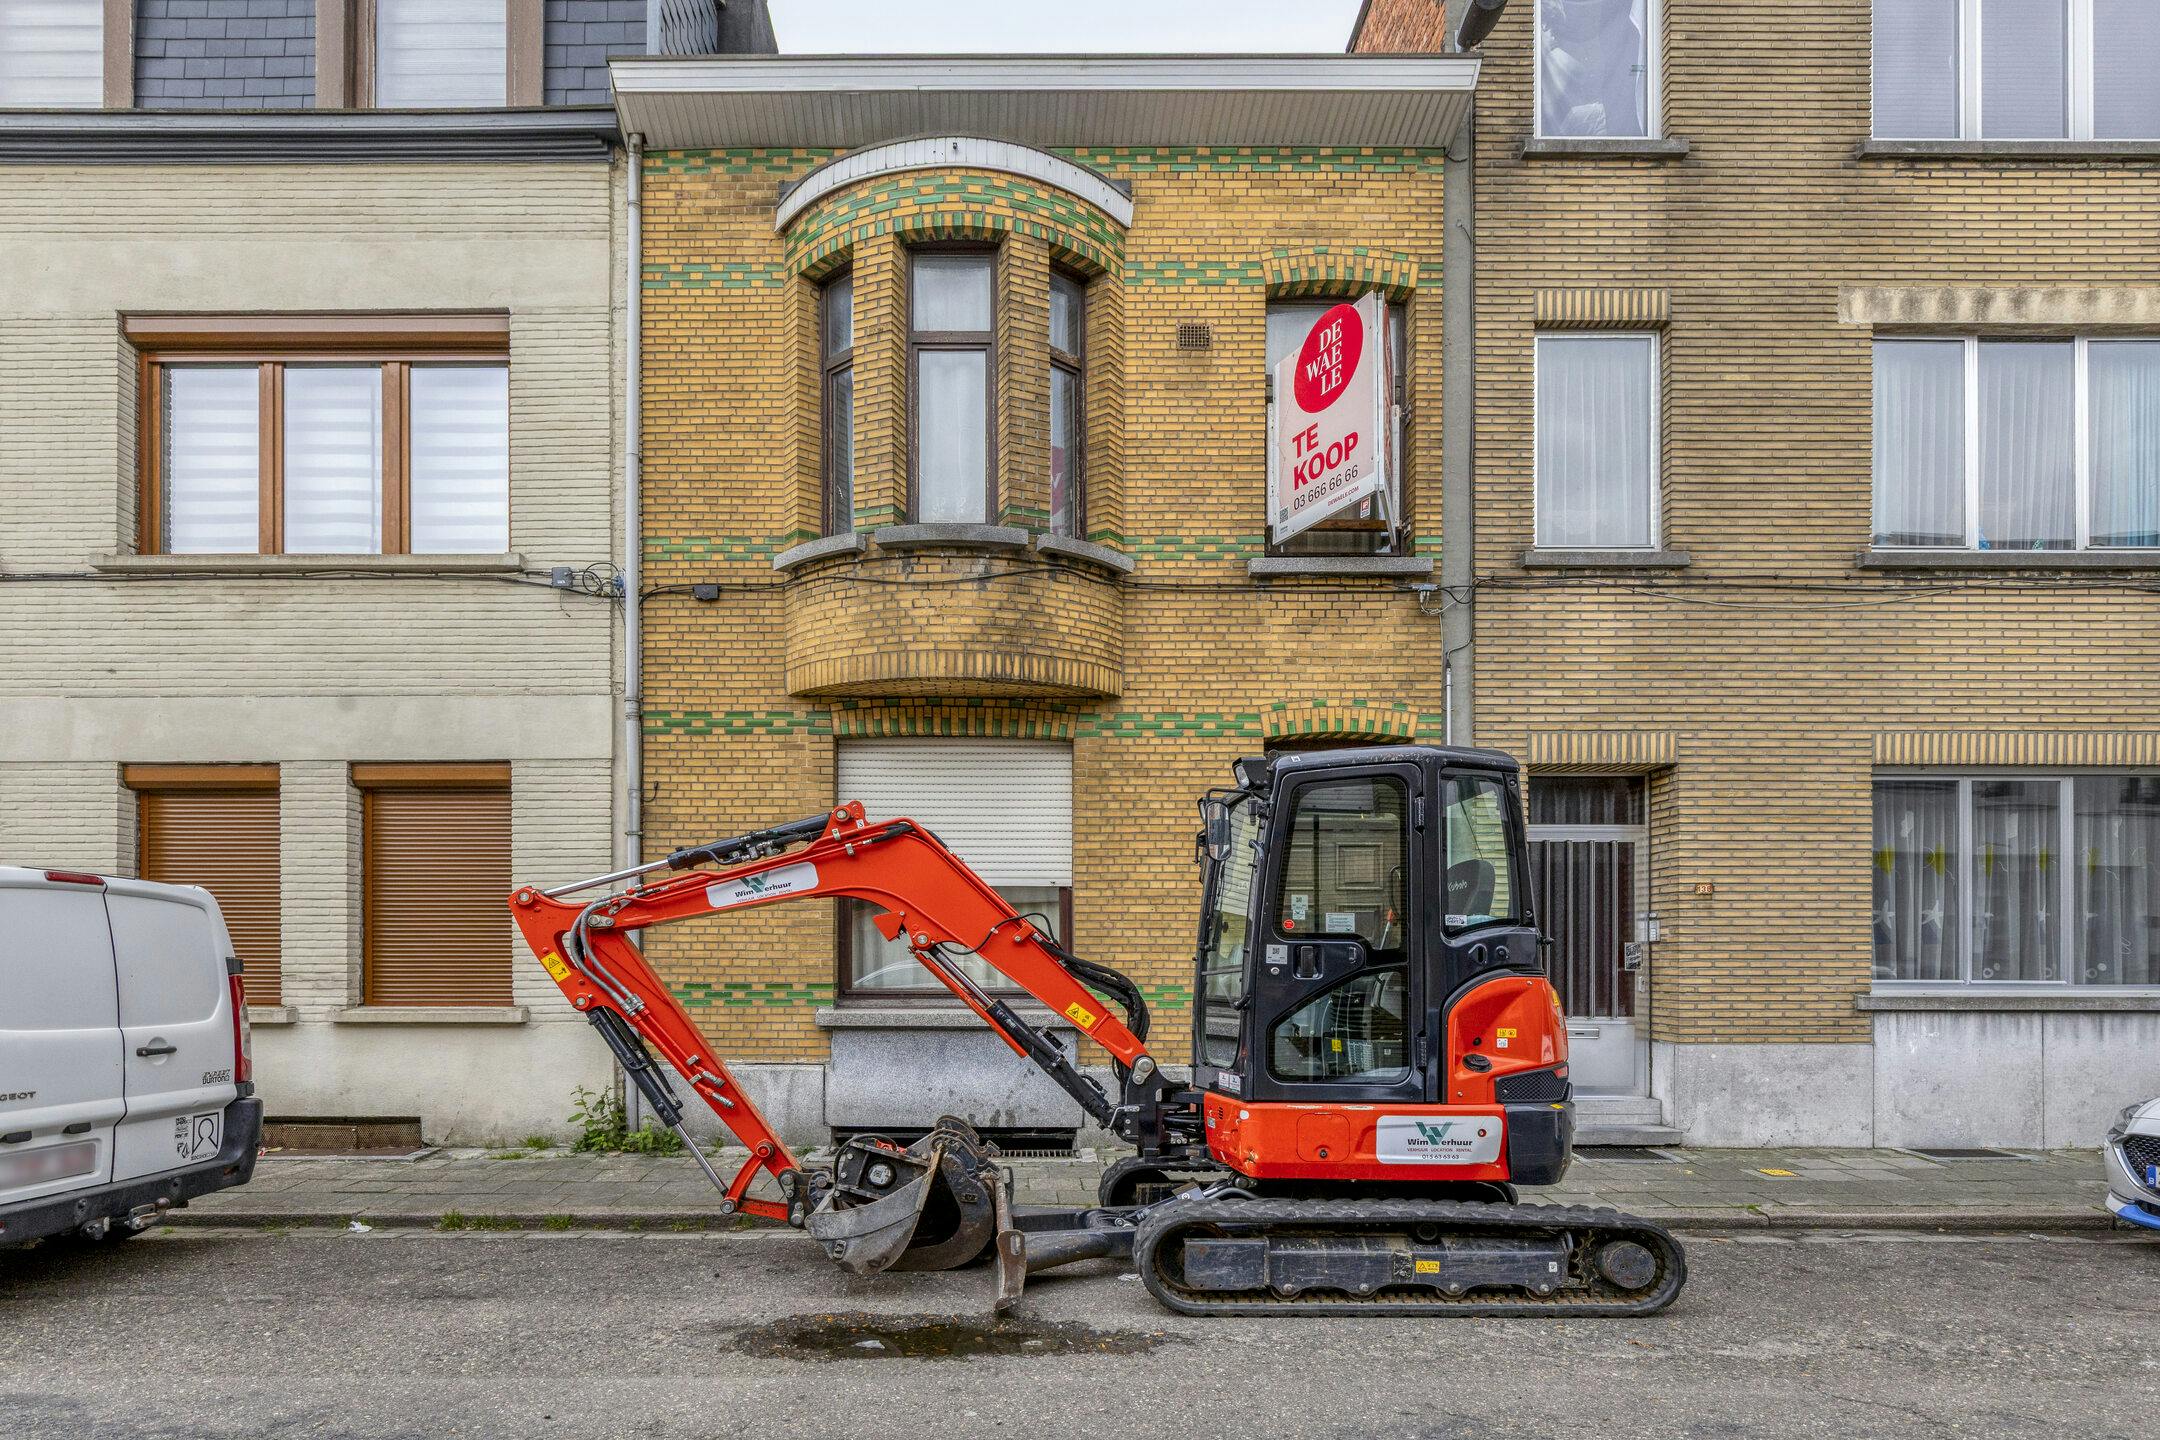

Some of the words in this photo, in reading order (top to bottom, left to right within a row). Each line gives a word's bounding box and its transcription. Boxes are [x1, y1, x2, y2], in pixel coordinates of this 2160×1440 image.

[1319, 318, 1343, 353] DE
[1305, 341, 1343, 382] WAE
[1320, 364, 1343, 396] LE
[1292, 423, 1319, 458] TE
[1293, 431, 1358, 490] KOOP
[1293, 494, 1306, 510] 03
[1307, 482, 1326, 502] 666
[1329, 473, 1342, 490] 66
[1345, 464, 1358, 483] 66
[735, 889, 754, 897] Wim
[1407, 1138, 1428, 1146] Wim
